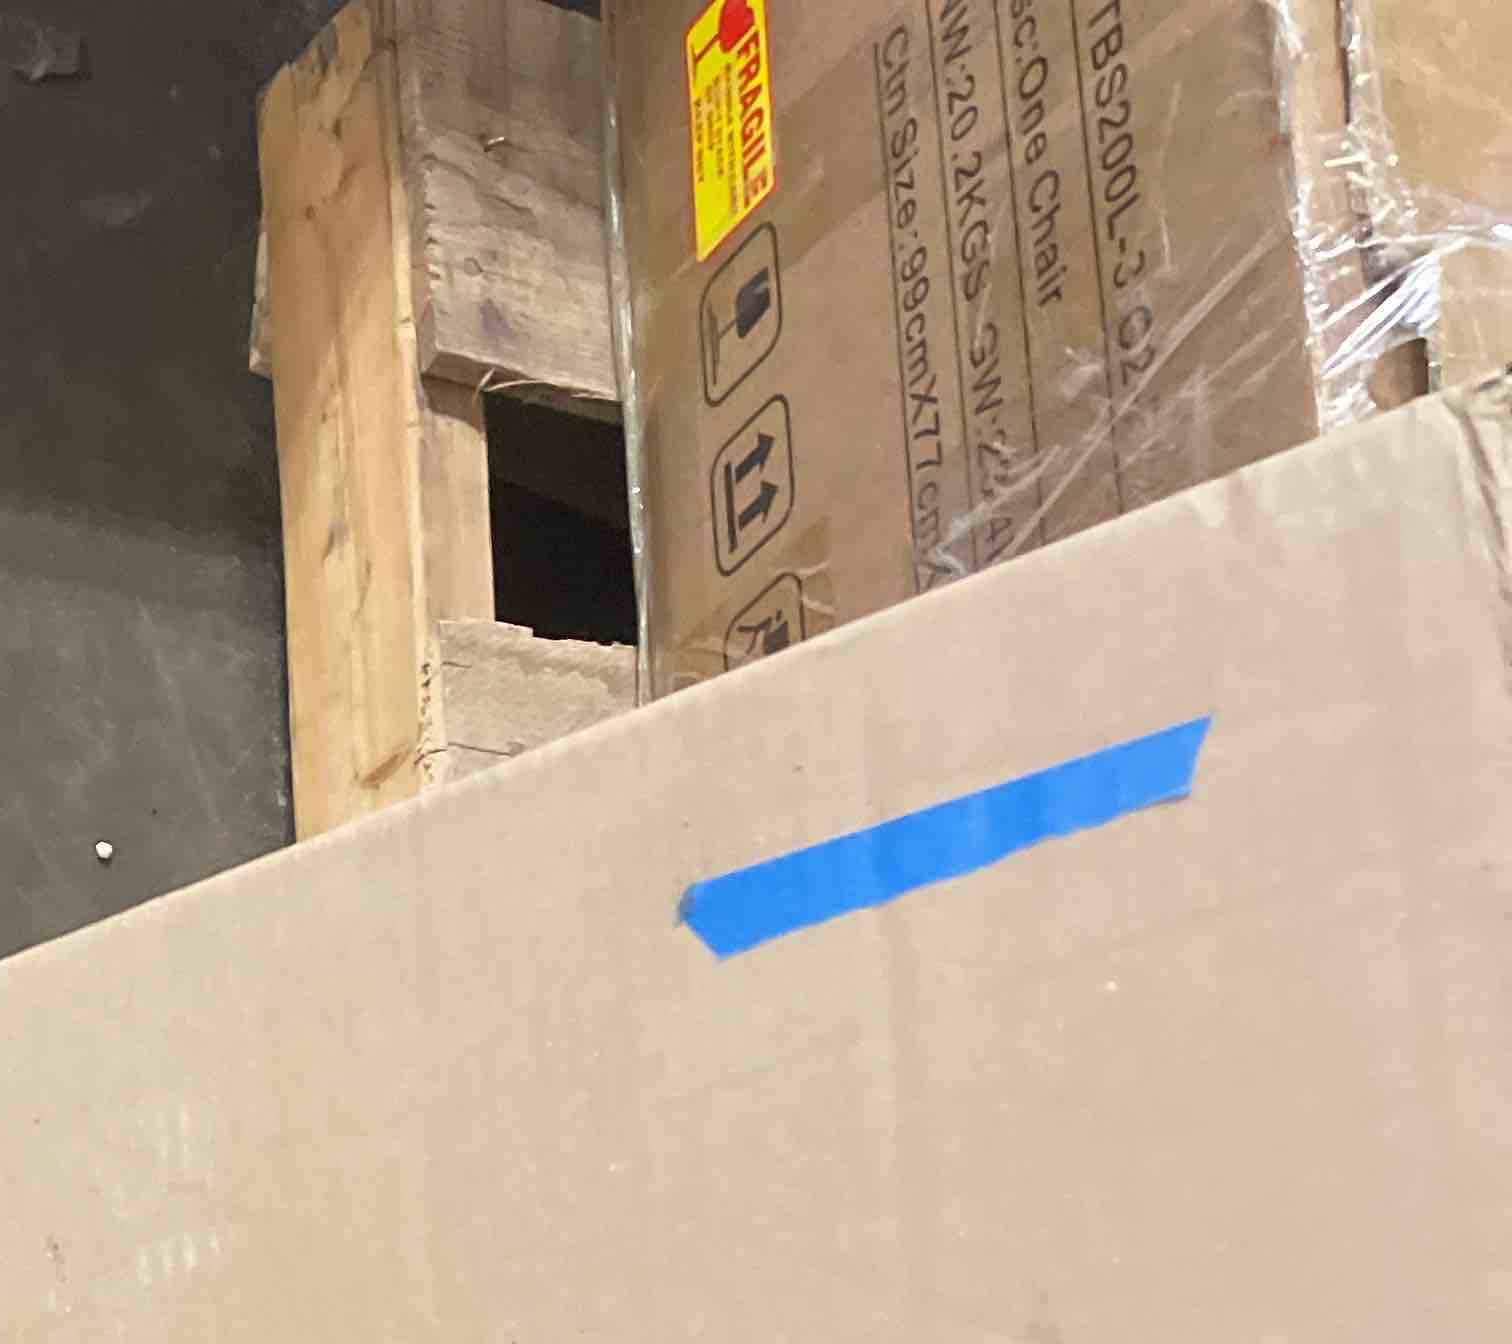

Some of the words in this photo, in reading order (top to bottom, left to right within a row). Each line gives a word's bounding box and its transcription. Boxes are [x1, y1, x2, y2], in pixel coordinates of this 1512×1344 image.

[737, 29, 768, 210] FRAGILE
[882, 24, 910, 117] Ctn
[1030, 169, 1068, 307] Chair
